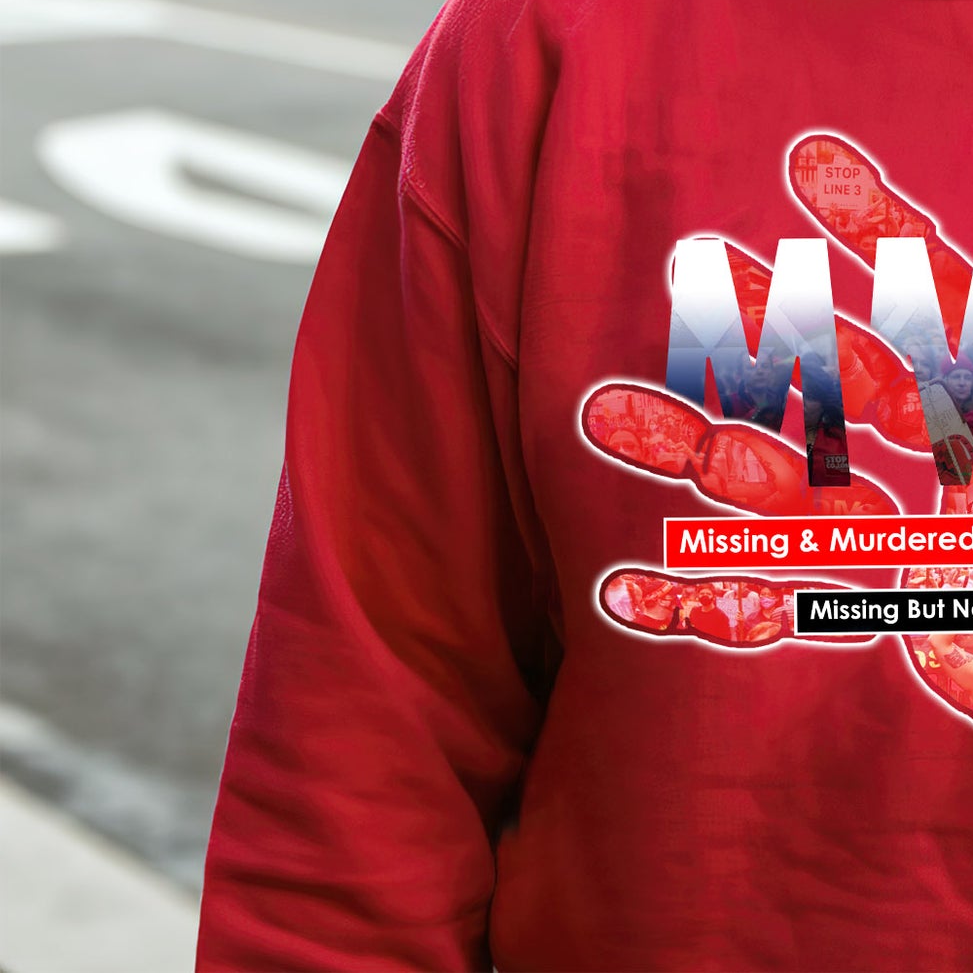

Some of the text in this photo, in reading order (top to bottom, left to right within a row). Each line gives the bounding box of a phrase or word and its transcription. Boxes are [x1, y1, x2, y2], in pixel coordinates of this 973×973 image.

[825, 167, 860, 179] STOP
[823, 184, 862, 196] LINE 3
[825, 455, 848, 463] STOP
[680, 526, 789, 559] Missing
[799, 529, 820, 553] &
[810, 599, 899, 626] Missing
[908, 598, 945, 619] But
